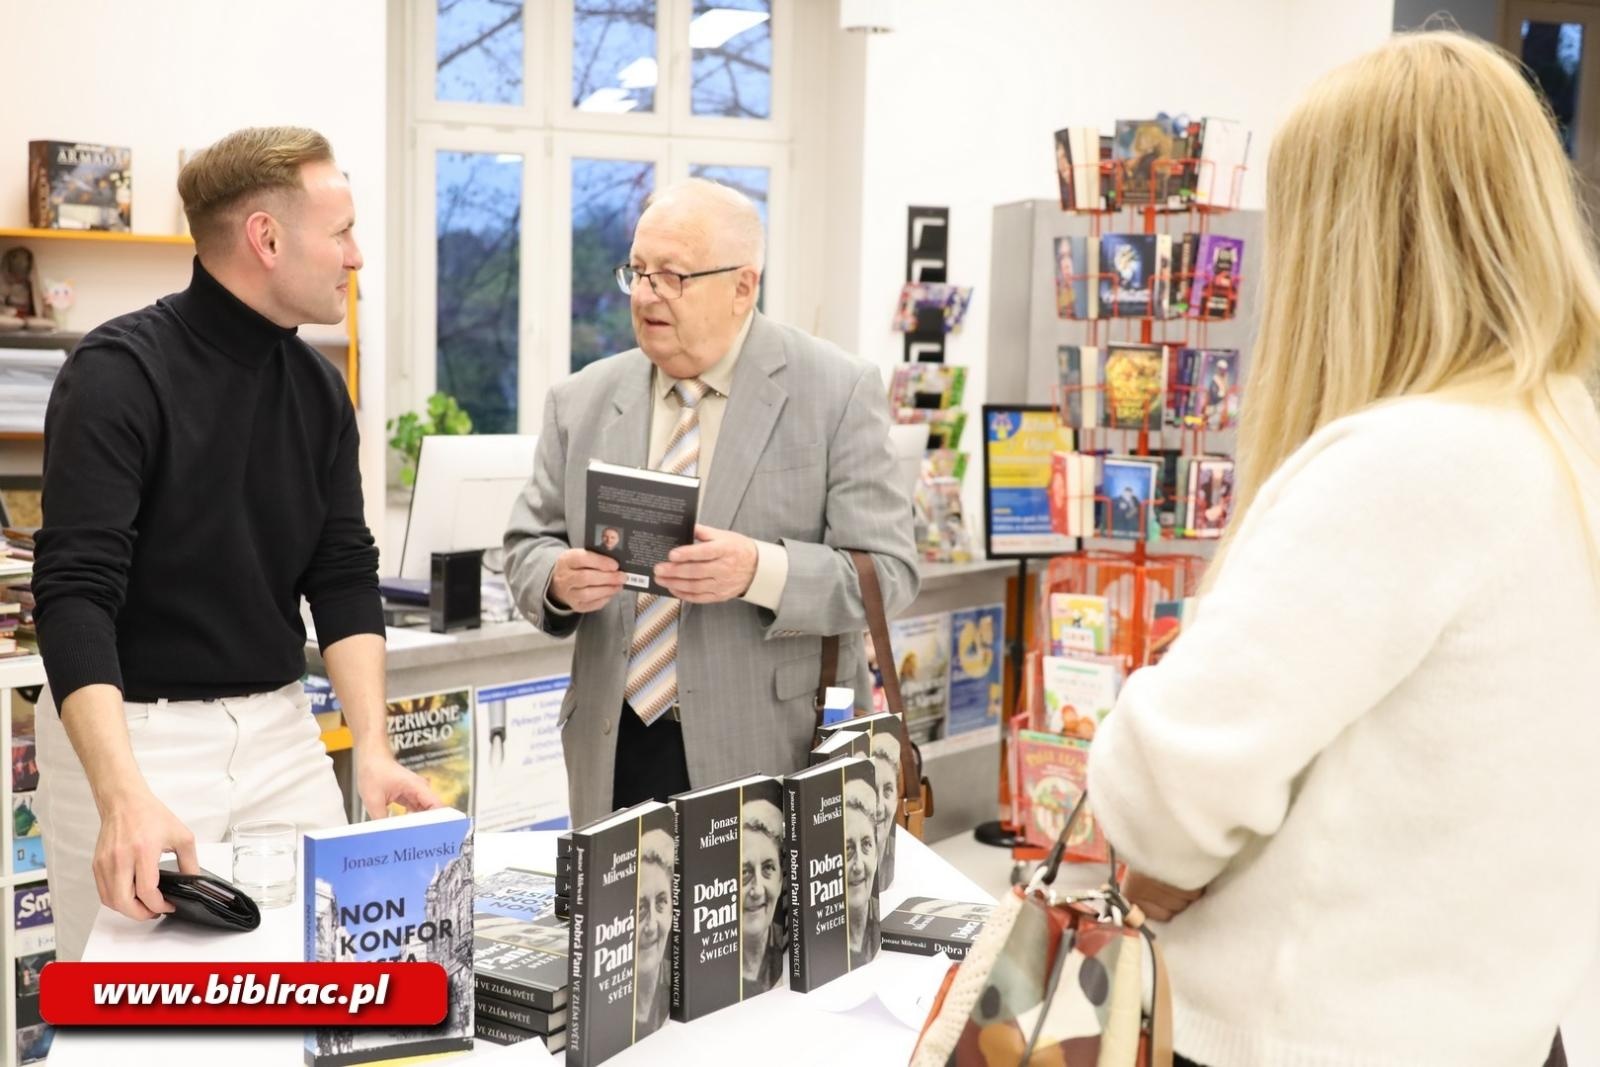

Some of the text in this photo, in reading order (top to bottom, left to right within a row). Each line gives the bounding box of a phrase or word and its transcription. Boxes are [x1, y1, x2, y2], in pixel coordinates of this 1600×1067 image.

[385, 704, 461, 735] ZERWONE
[820, 794, 842, 812] Jonasz
[709, 816, 738, 835] Jonasz
[813, 806, 842, 826] Milewski
[699, 828, 738, 849] Milewski
[342, 842, 456, 873] Jonasz Milewski
[611, 848, 637, 871] Jonasz
[790, 849, 799, 880] Dobra
[809, 853, 844, 878] Dobra
[602, 862, 637, 887] Milewski
[672, 873, 681, 906] Dobra
[693, 877, 738, 904] Dobra
[791, 883, 800, 906] Pani
[810, 869, 844, 907] Pani
[340, 897, 406, 926] NON
[672, 908, 681, 933] Pani
[693, 894, 738, 934] Pani
[825, 901, 845, 917] ZŁYM
[340, 918, 454, 956] KONFOR
[573, 913, 584, 949] Dobrá
[595, 908, 635, 946] Dobrá
[712, 927, 738, 944] ZŁYM
[816, 914, 846, 935] ŚWIECIE
[593, 932, 634, 978] Paní
[700, 941, 738, 964] ŚWIECIE
[881, 937, 900, 945] Jonasz
[901, 939, 927, 948] Milewski
[934, 943, 963, 955] Dobra
[480, 981, 489, 990] VE
[491, 983, 512, 996] ZLÉM
[599, 967, 633, 992] VE ZLÉM
[477, 1002, 487, 1011] VE
[488, 1005, 508, 1018] ZLÉM
[476, 1025, 528, 1043] VE ZLÉM SVĚ
